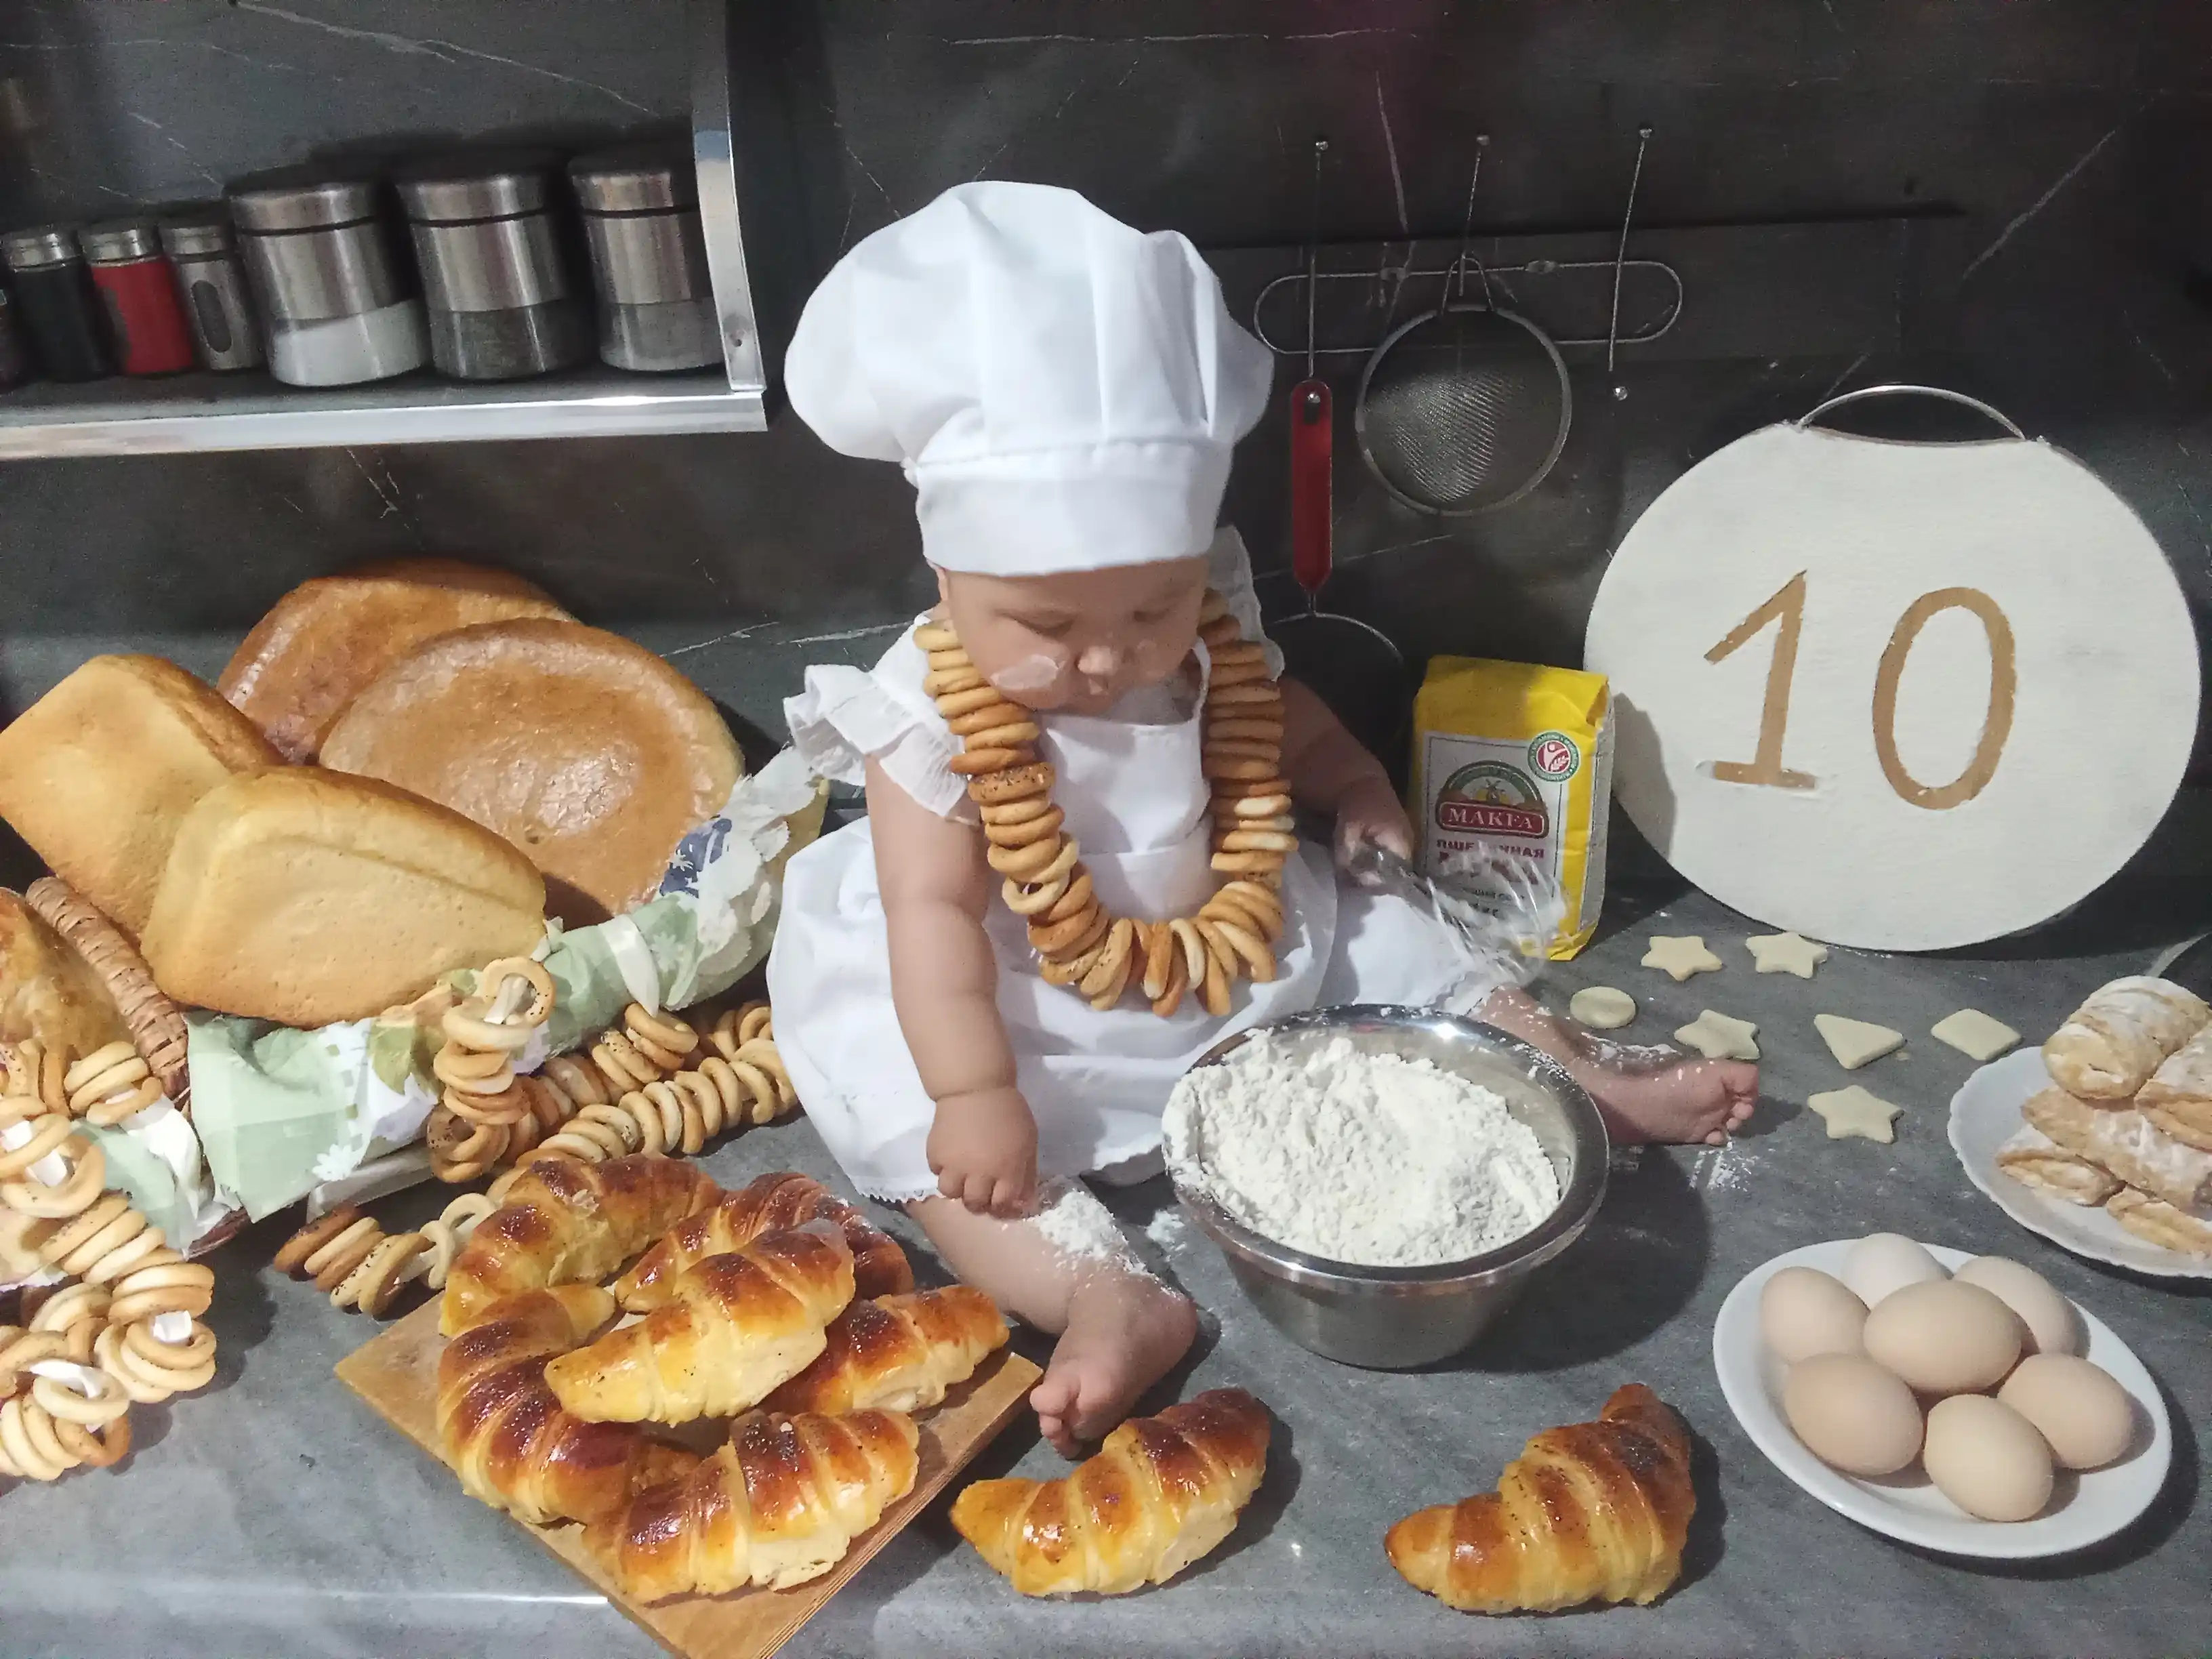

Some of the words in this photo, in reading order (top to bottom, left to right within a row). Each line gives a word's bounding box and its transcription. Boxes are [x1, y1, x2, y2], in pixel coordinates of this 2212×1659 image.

[1700, 569, 2017, 811] 10
[1448, 807, 1533, 830] MAKFA
[1436, 838, 1545, 859] ПШЕЧНАЯ
